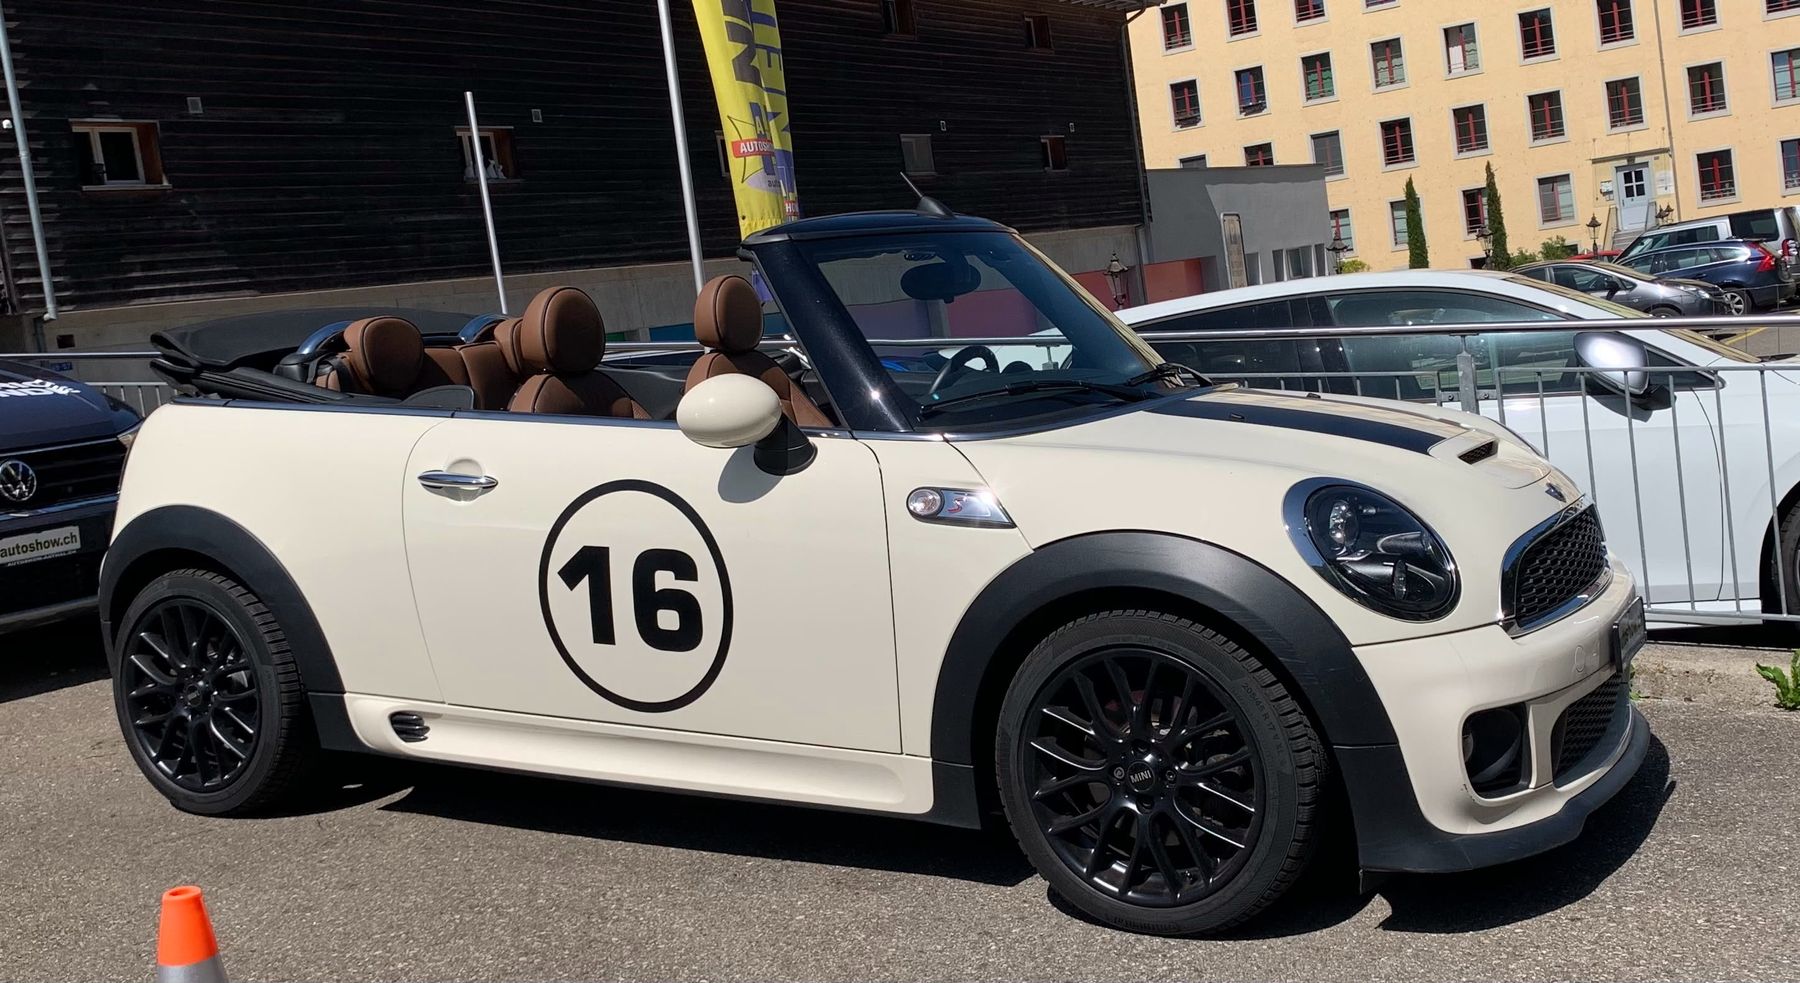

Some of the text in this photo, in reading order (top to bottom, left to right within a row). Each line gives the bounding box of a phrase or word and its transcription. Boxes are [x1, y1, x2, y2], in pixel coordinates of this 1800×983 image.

[0, 532, 78, 558] autoshow.ch
[557, 545, 704, 652] 16
[1130, 770, 1152, 783] MINI
